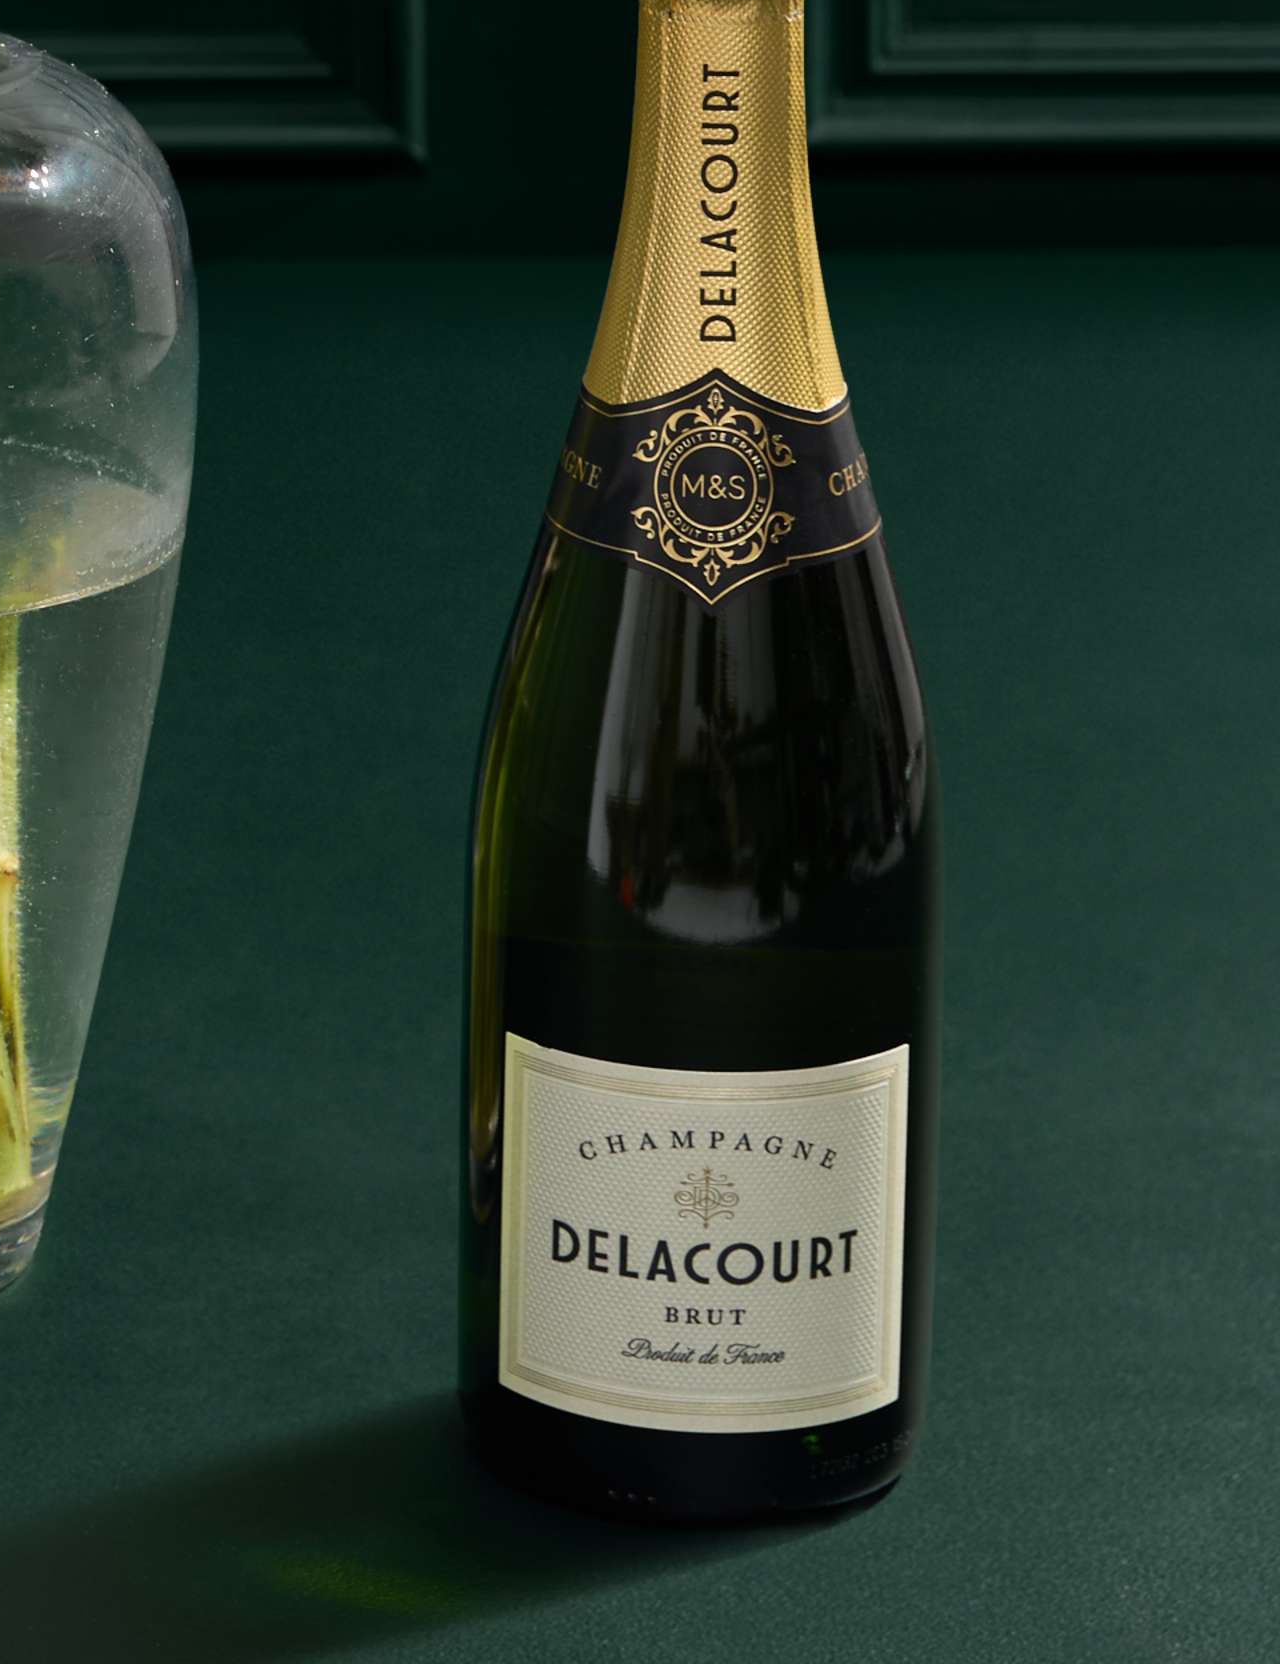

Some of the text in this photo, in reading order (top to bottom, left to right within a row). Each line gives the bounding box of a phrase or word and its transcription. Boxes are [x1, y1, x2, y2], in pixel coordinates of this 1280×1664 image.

[699, 63, 740, 343] DELACOURT
[661, 431, 767, 480] PRODUIT DE FRANCE
[681, 473, 746, 501] M&S
[661, 492, 767, 542] PRODUIT DE FRANCE
[578, 1129, 838, 1170] CHAMPAGNE
[551, 1218, 859, 1286] DELACOURT
[664, 1306, 747, 1326] BRUT
[621, 1337, 786, 1365] Produit de France
